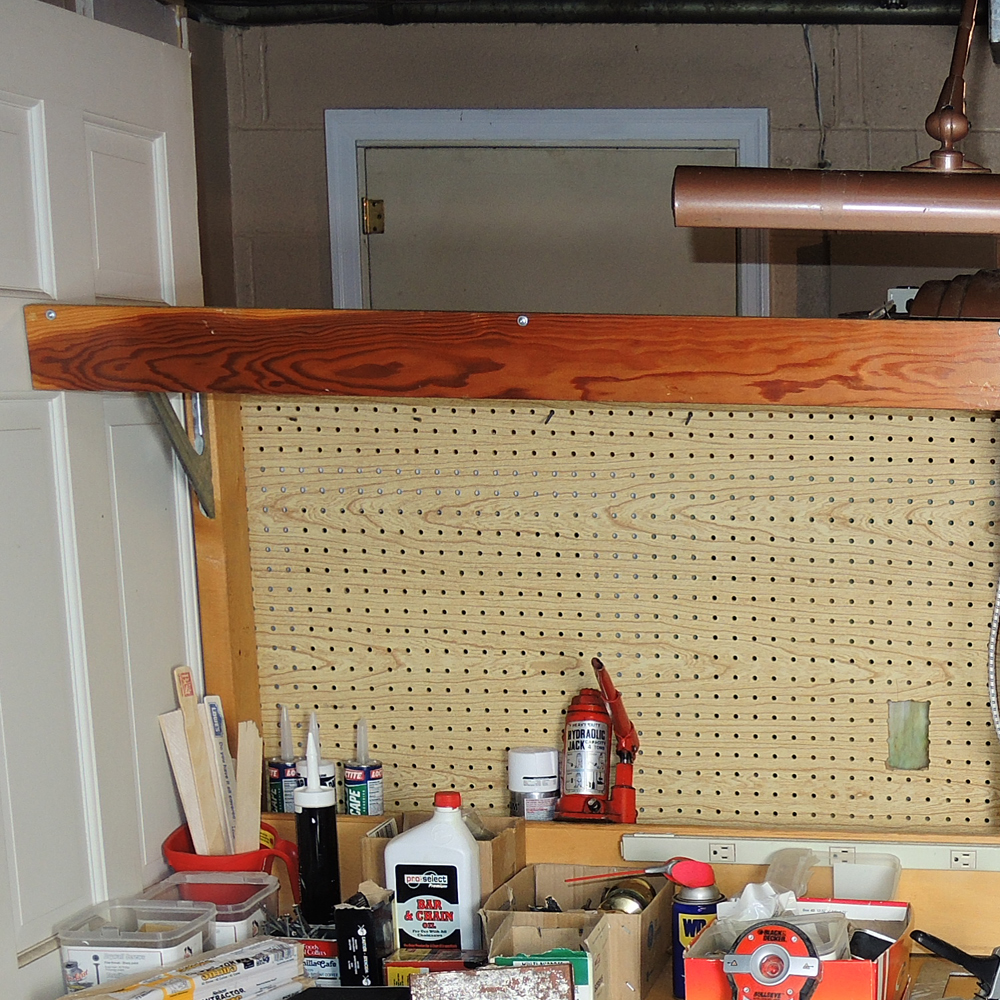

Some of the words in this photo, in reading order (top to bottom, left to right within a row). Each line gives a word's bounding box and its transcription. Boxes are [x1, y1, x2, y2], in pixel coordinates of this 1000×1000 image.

[567, 740, 585, 751] JACK
[417, 899, 442, 910] BAR
[404, 910, 413, 921] &
[416, 911, 454, 921] CHAIN
